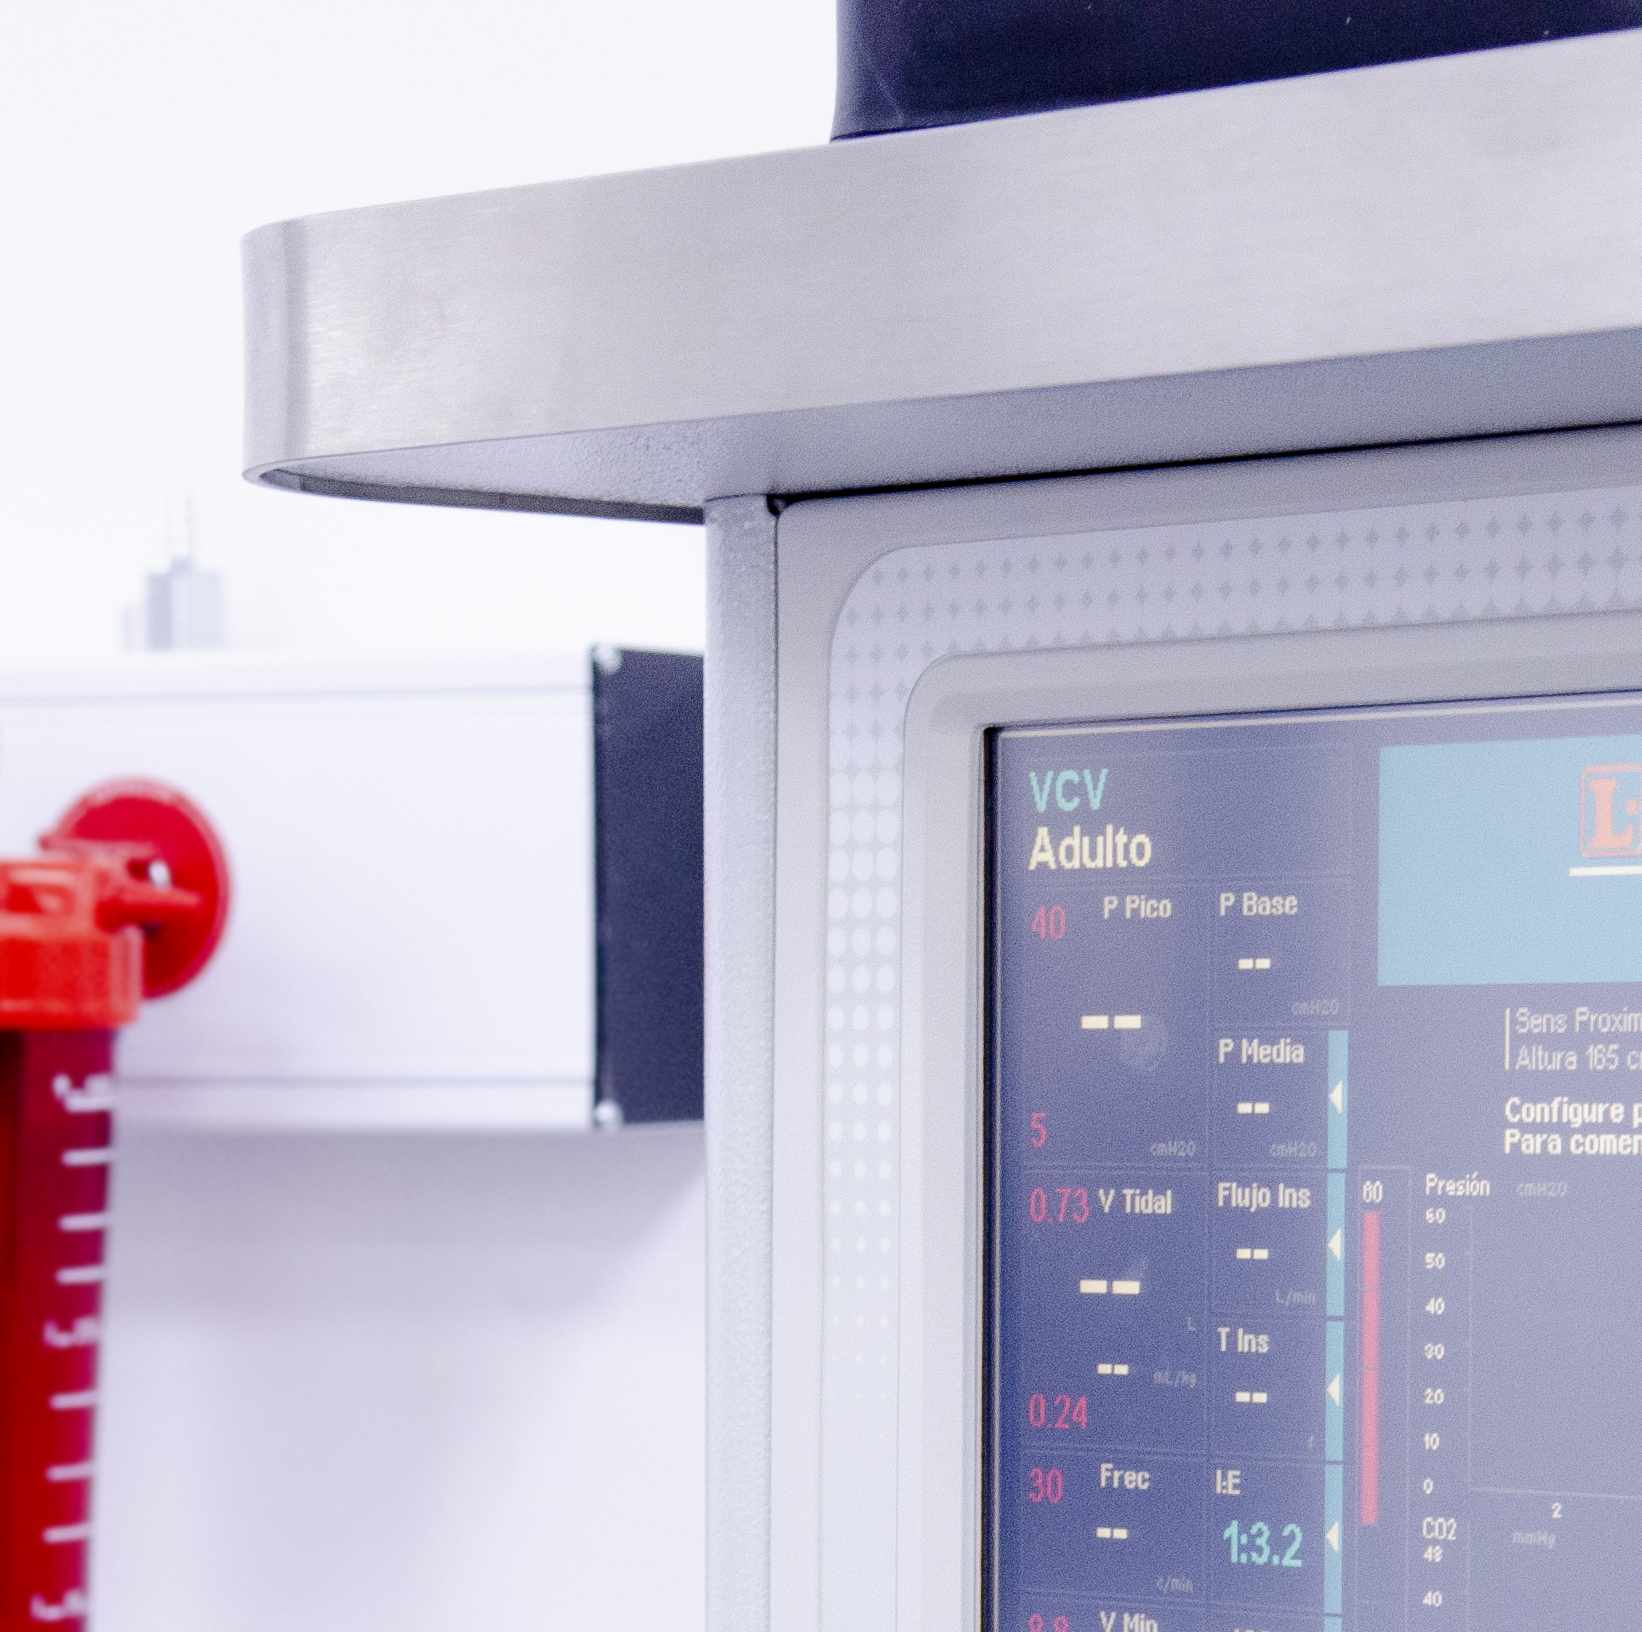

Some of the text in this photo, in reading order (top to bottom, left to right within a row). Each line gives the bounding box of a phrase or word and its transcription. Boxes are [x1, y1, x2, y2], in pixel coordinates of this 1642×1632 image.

[1029, 769, 1108, 813] VCV
[1029, 825, 1151, 870] Adulto
[1103, 896, 1172, 918] P Pico
[1220, 893, 1298, 916] P Base
[1031, 906, 1066, 939] 40
[1515, 1006, 1568, 1034] Sens
[1218, 1038, 1305, 1064] P Media
[1514, 1044, 1578, 1071] Altura
[1585, 1043, 1619, 1071] 165
[1504, 1096, 1625, 1128] Configure
[1030, 1112, 1047, 1147] 5
[1504, 1128, 1562, 1155] Para
[1425, 1171, 1490, 1196] Presión
[1029, 1188, 1090, 1223] 0.73
[1099, 1189, 1172, 1214] V Tidal
[1217, 1182, 1311, 1212] Flujo Ins
[1424, 1252, 1445, 1270] 50
[1424, 1297, 1445, 1315] 40
[1217, 1328, 1269, 1354] T Ins
[1424, 1388, 1444, 1404] 20
[1028, 1394, 1088, 1429] 0.24
[1423, 1432, 1440, 1450] 10
[1029, 1468, 1064, 1504] 30
[1100, 1463, 1150, 1490] Frec
[1215, 1469, 1241, 1495] I:E
[1423, 1477, 1434, 1495] 0
[1551, 1502, 1562, 1519] 2
[1422, 1516, 1457, 1541] CO2
[1222, 1520, 1303, 1567] 1:3.2
[1422, 1591, 1443, 1607] 40
